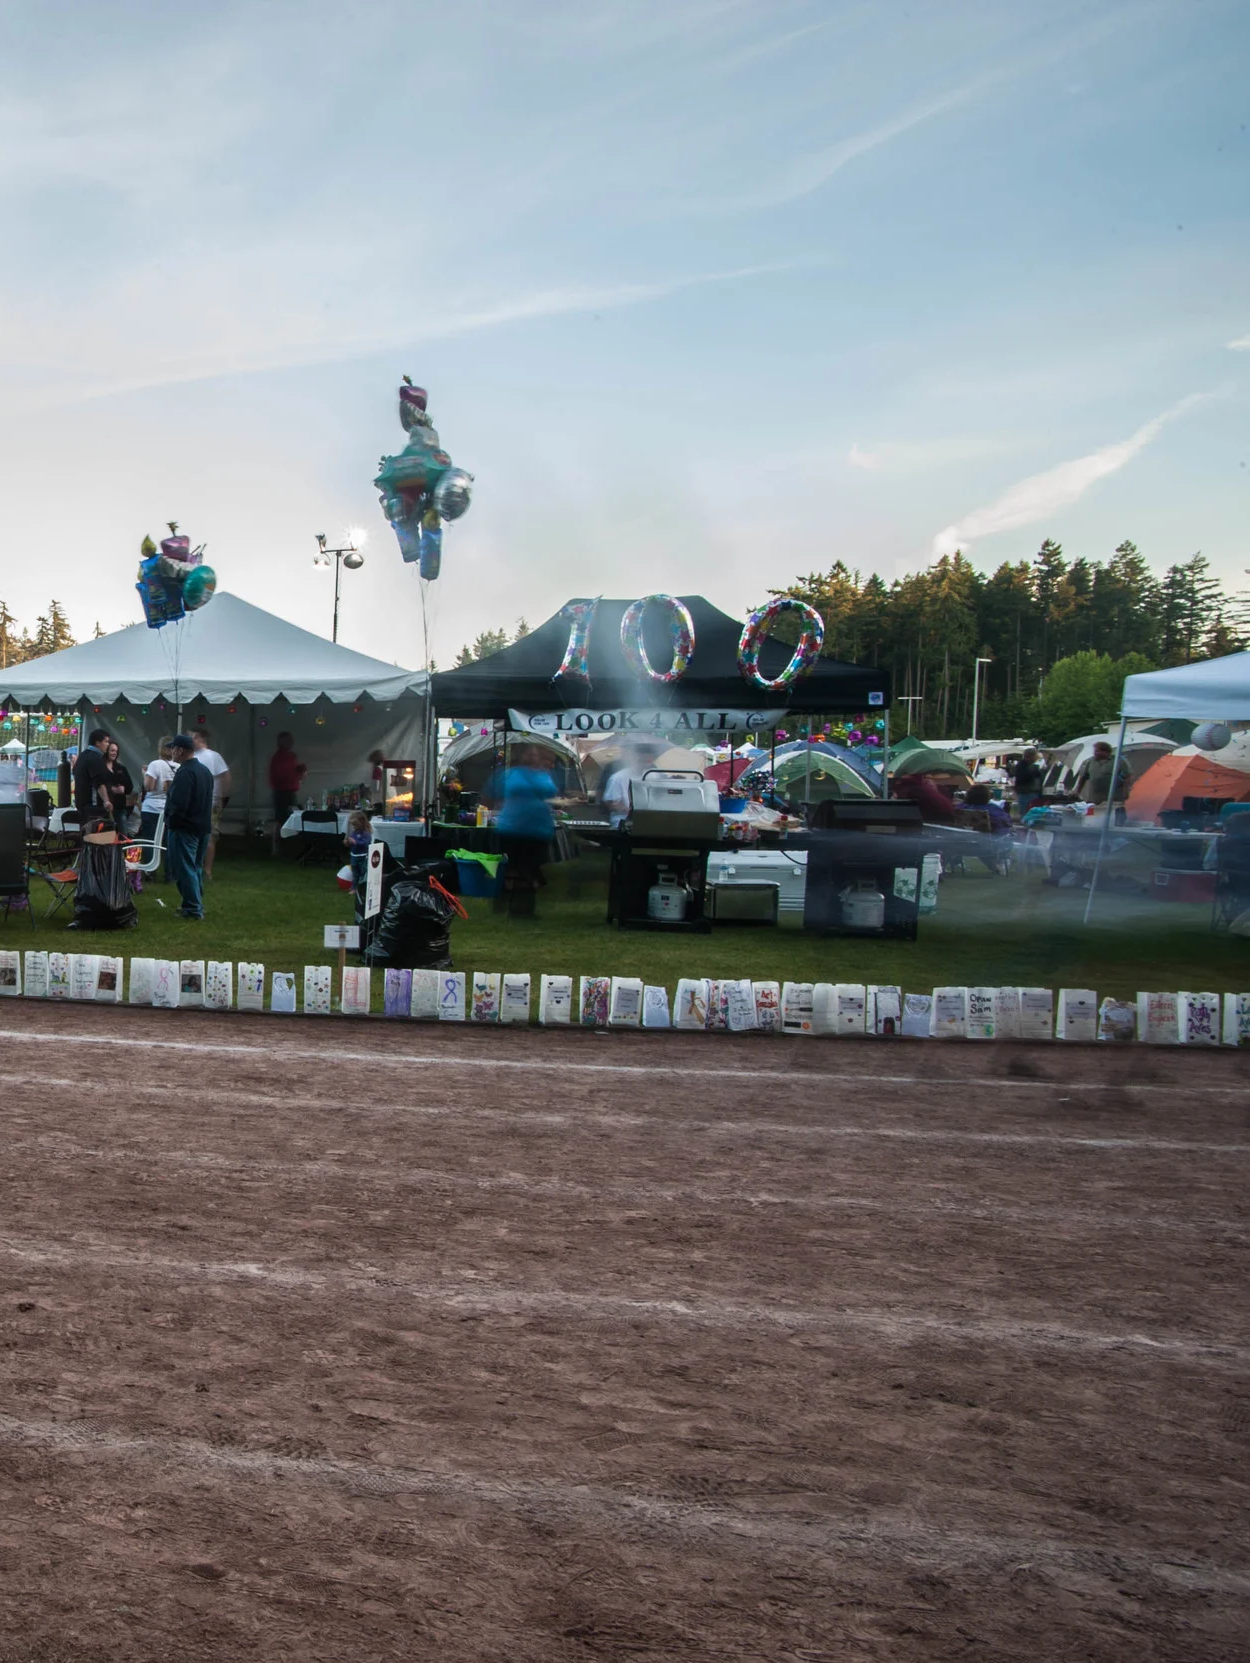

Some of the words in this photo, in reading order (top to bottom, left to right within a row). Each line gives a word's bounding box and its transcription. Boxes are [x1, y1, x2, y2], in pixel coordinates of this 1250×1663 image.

[555, 711, 639, 731] LOOK
[649, 711, 662, 729] 4
[673, 712, 737, 731] ALL
[970, 1004, 992, 1014] Sam
